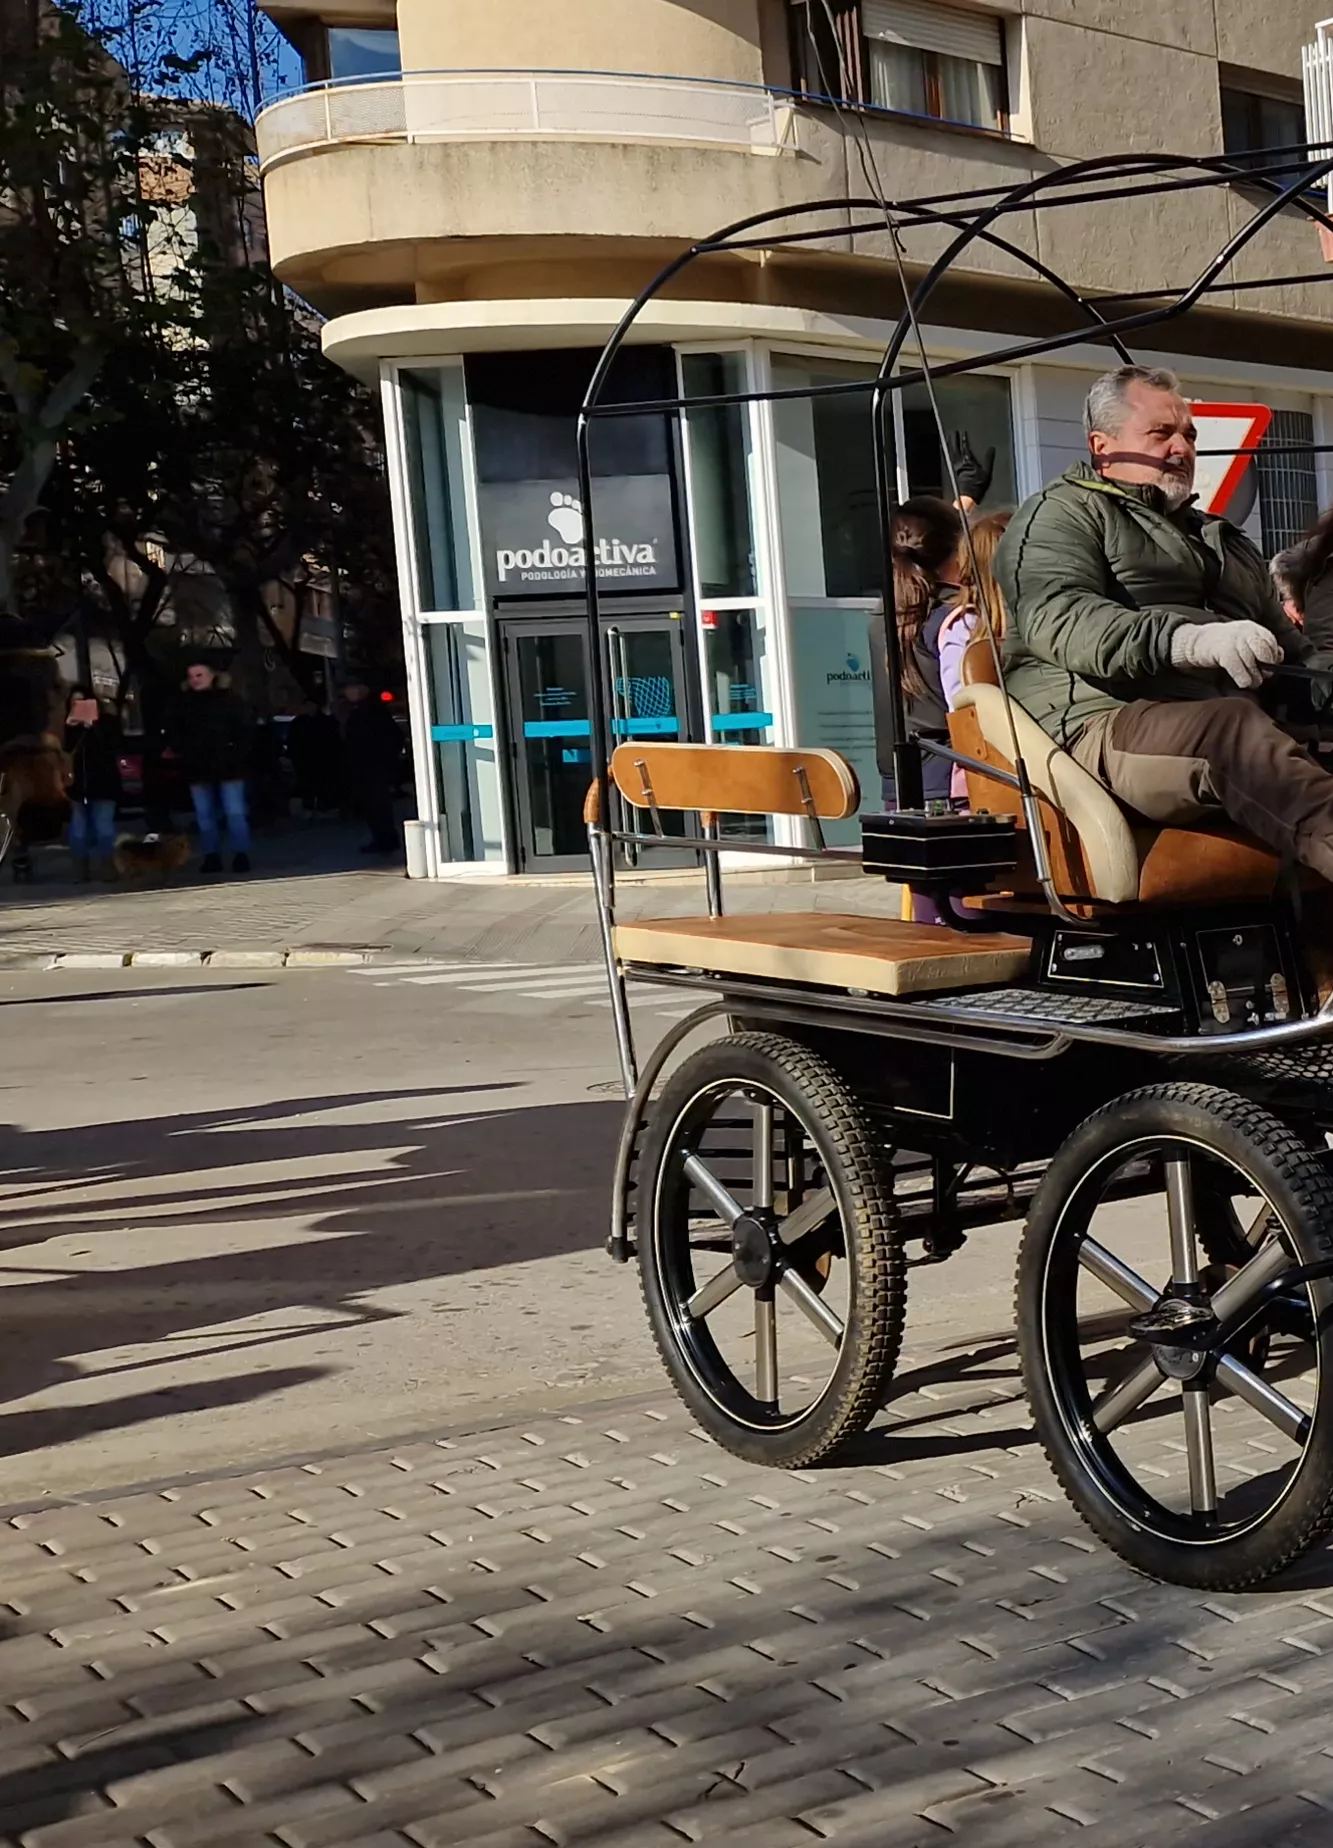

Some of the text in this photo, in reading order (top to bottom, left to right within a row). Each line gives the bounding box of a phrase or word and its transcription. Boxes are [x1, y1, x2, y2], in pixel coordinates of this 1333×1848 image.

[521, 568, 578, 581] PODOLOGÍA
[595, 565, 657, 578] IOMECÁNICA
[827, 670, 871, 685] podoacti
